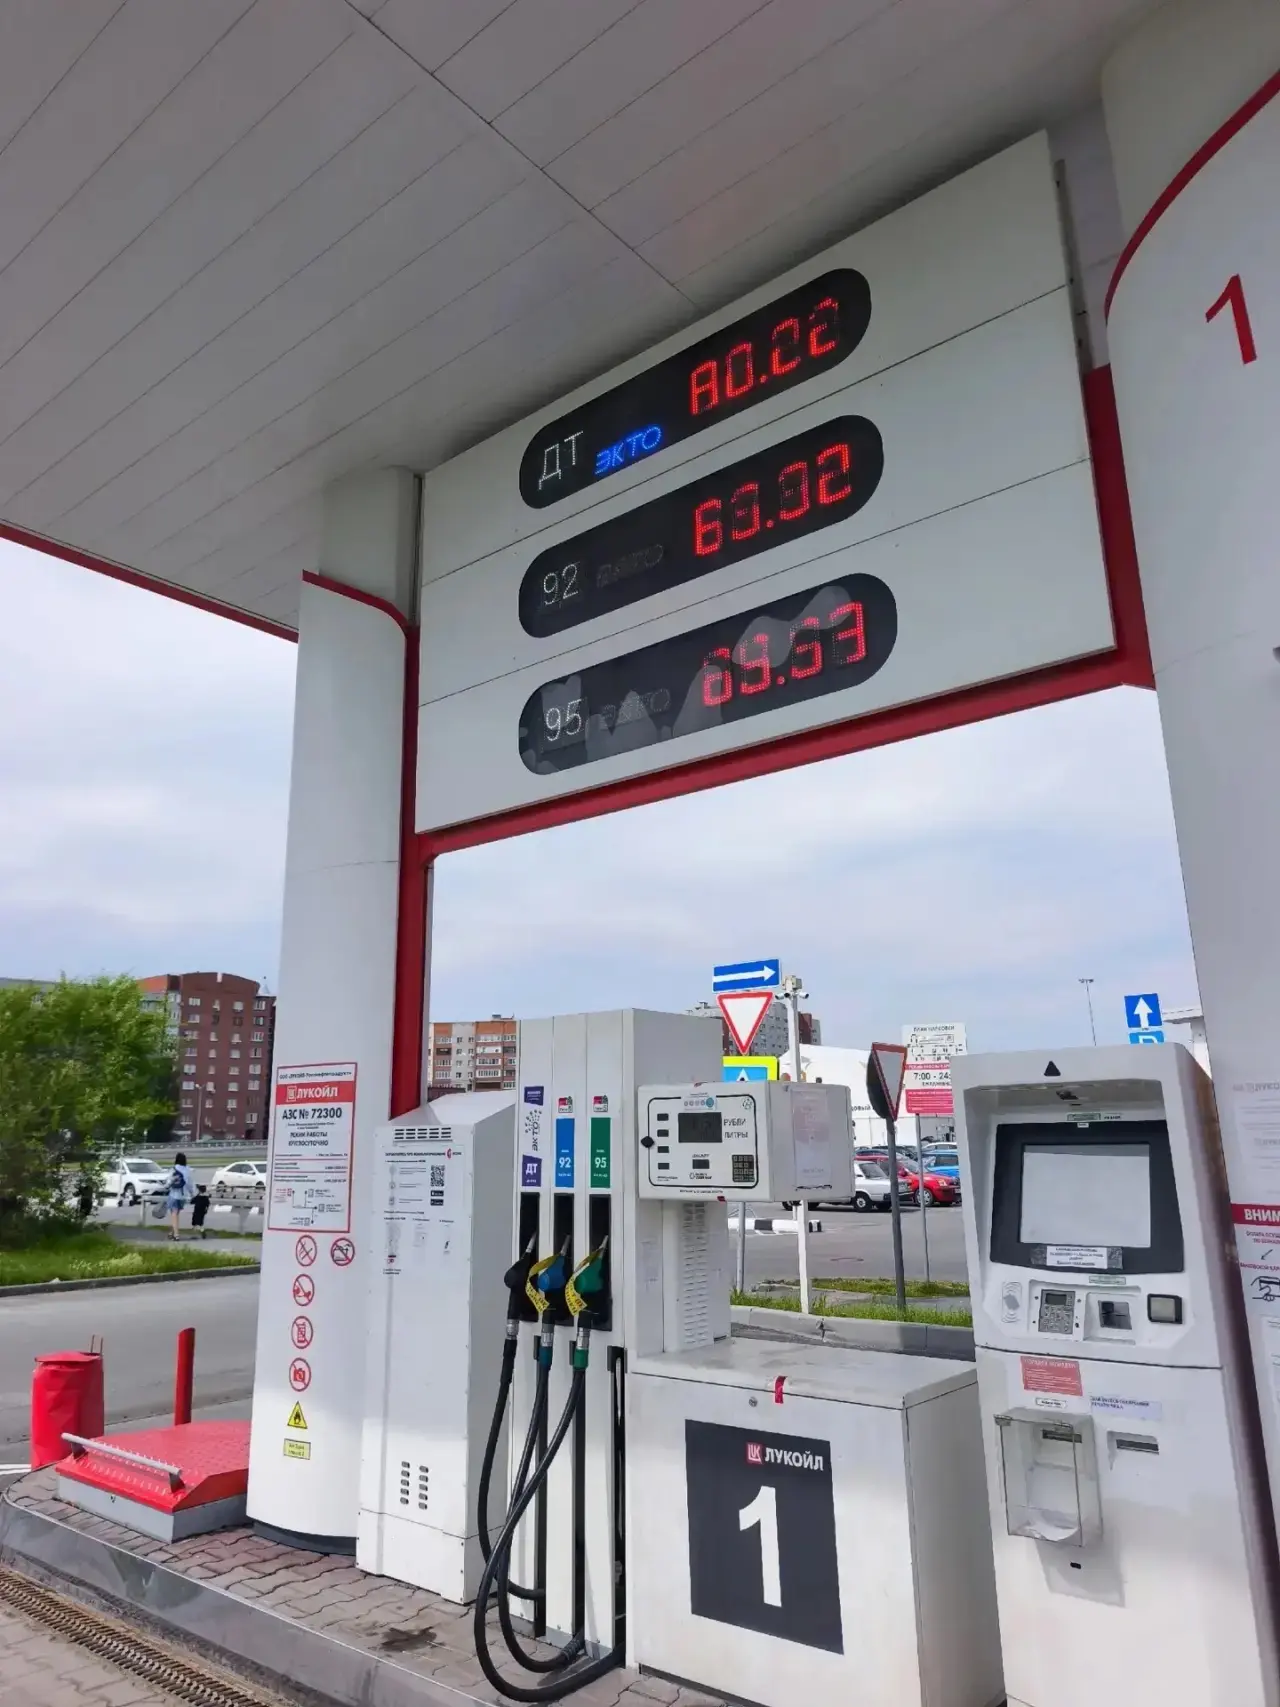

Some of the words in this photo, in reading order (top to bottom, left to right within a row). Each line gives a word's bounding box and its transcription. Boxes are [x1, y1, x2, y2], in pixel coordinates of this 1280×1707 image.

[1205, 273, 1257, 365] 1
[538, 430, 584, 491] ДТ
[593, 425, 662, 475] ЭКТО
[543, 562, 580, 606] 92
[545, 698, 583, 742] 95
[913, 1072, 931, 1081] 7:00
[297, 1084, 338, 1099] ЛУКОЙЛ
[282, 1108, 297, 1120] АЗС
[311, 1107, 343, 1119] 72300
[525, 1163, 538, 1176] ДТ
[559, 1157, 572, 1168] 92
[594, 1156, 607, 1168] 95
[765, 1447, 824, 1472] ЛУКОЙЛ
[738, 1484, 782, 1608] 1
